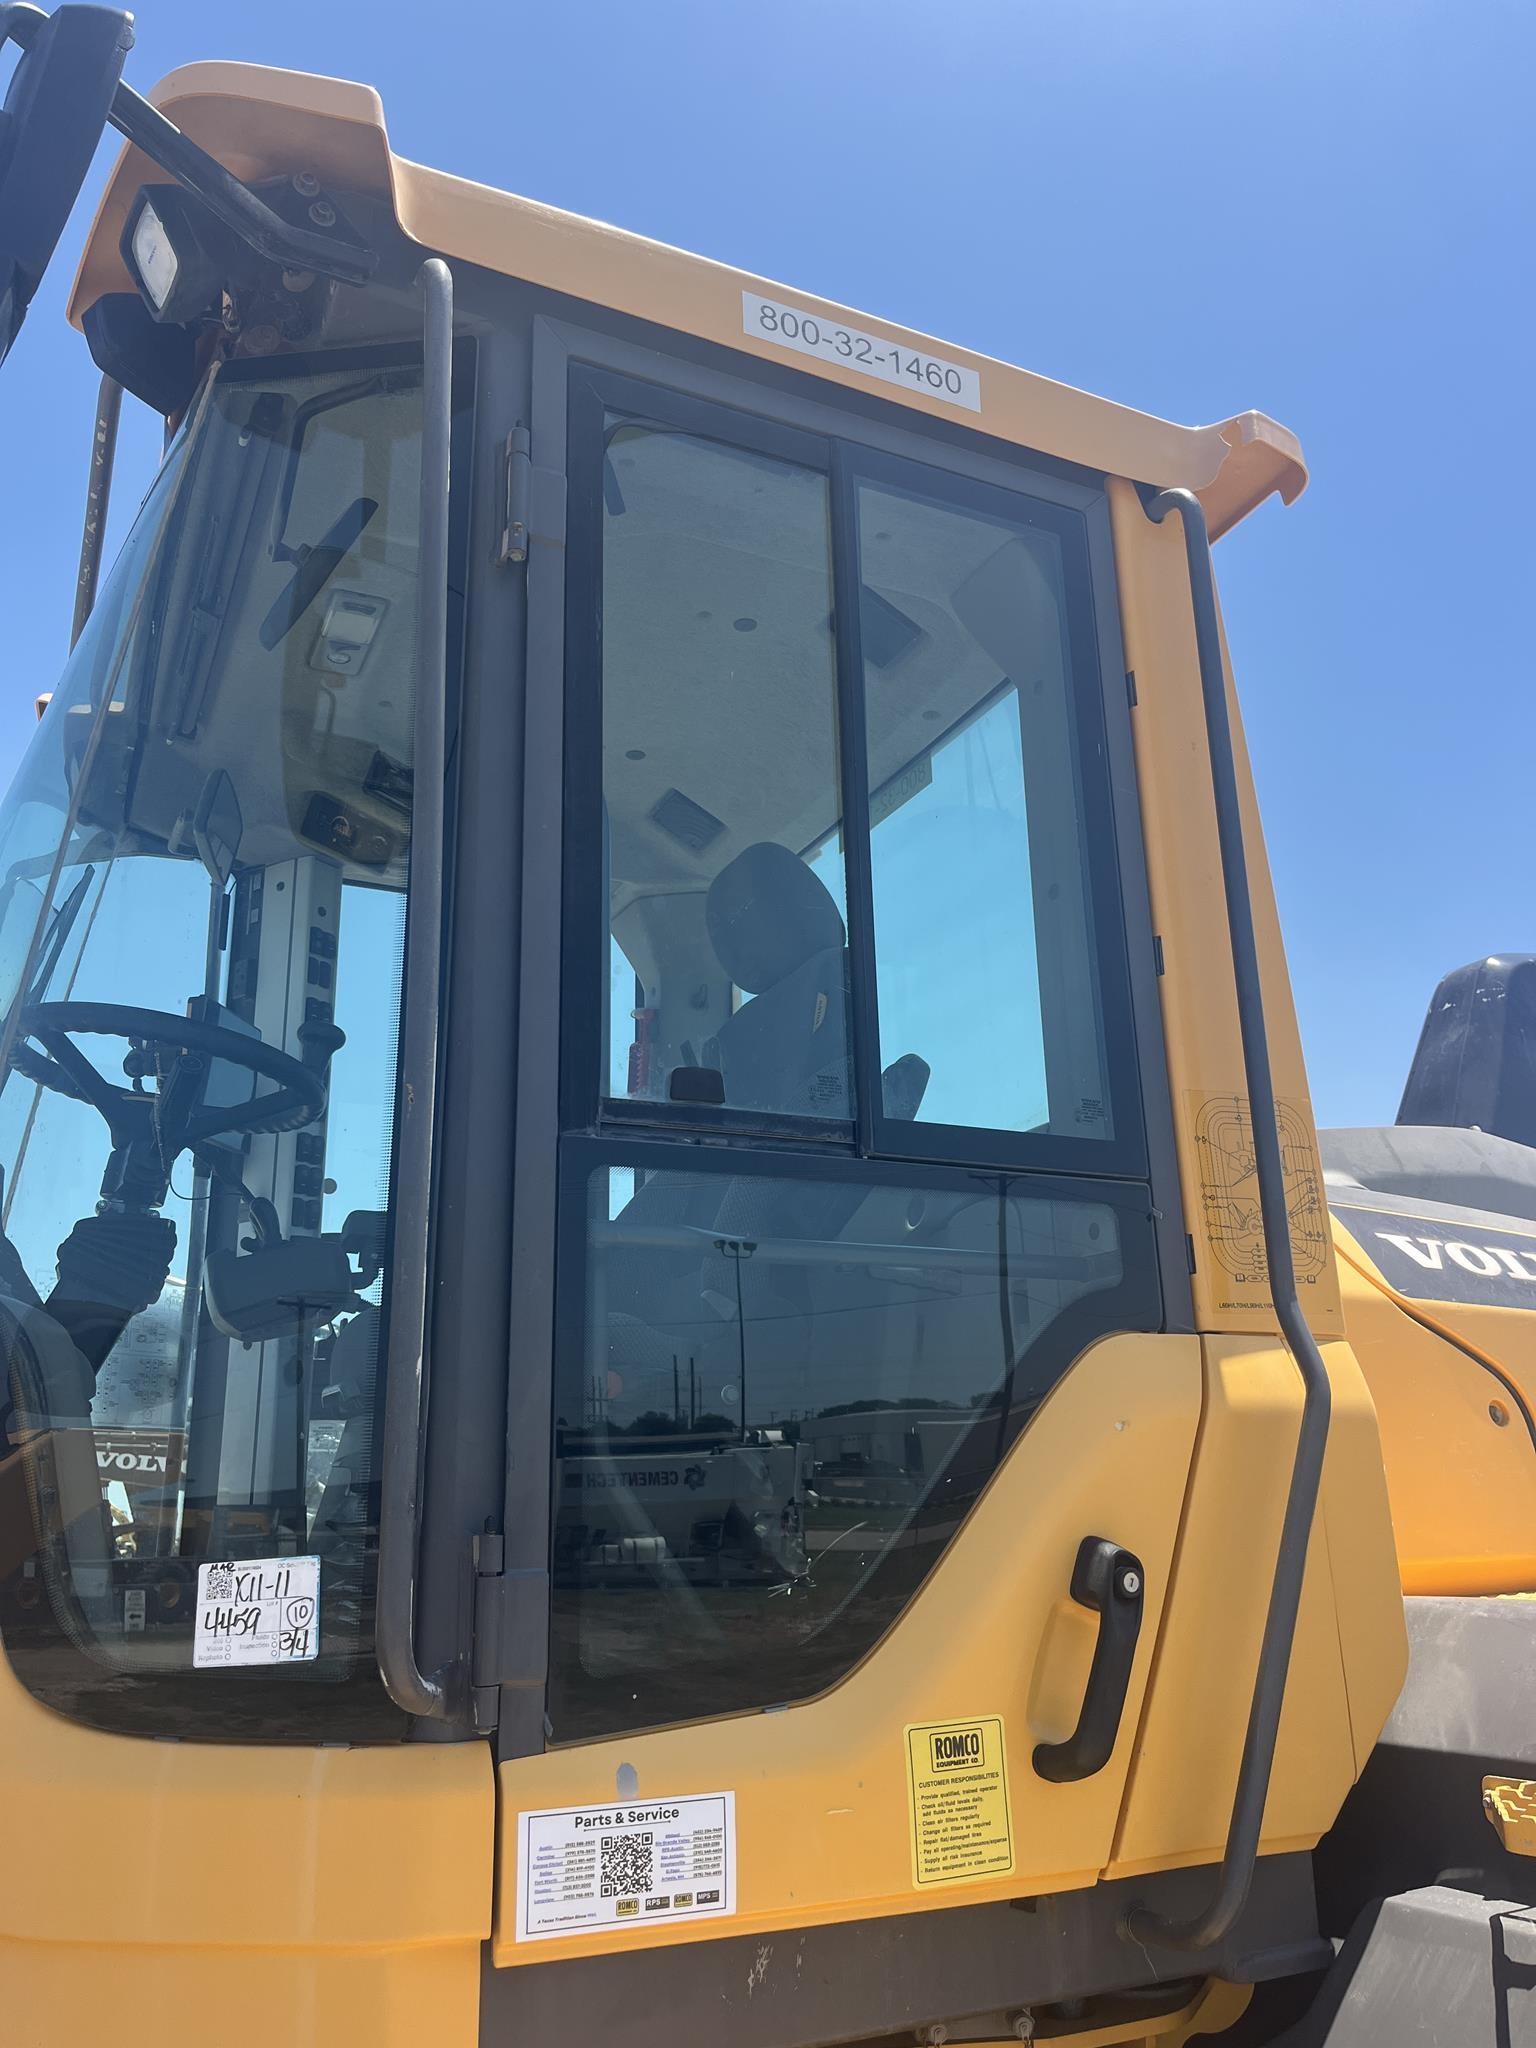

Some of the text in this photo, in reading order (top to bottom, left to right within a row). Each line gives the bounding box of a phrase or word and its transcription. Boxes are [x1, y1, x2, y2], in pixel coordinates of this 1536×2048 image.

[759, 304, 962, 395] 800-32-1460
[294, 1605, 309, 1622] 10
[204, 1607, 261, 1637] 4459
[935, 1733, 980, 1760] ROMCO
[936, 1758, 969, 1768] EQUIPMENT
[918, 1772, 999, 1788] CUSTOMER RESPONSIBILITIES
[921, 1793, 938, 1801] Provide
[575, 1806, 680, 1828] Parts & Service
[618, 1900, 638, 1910] ROMCO
[646, 1898, 660, 1907] RPS
